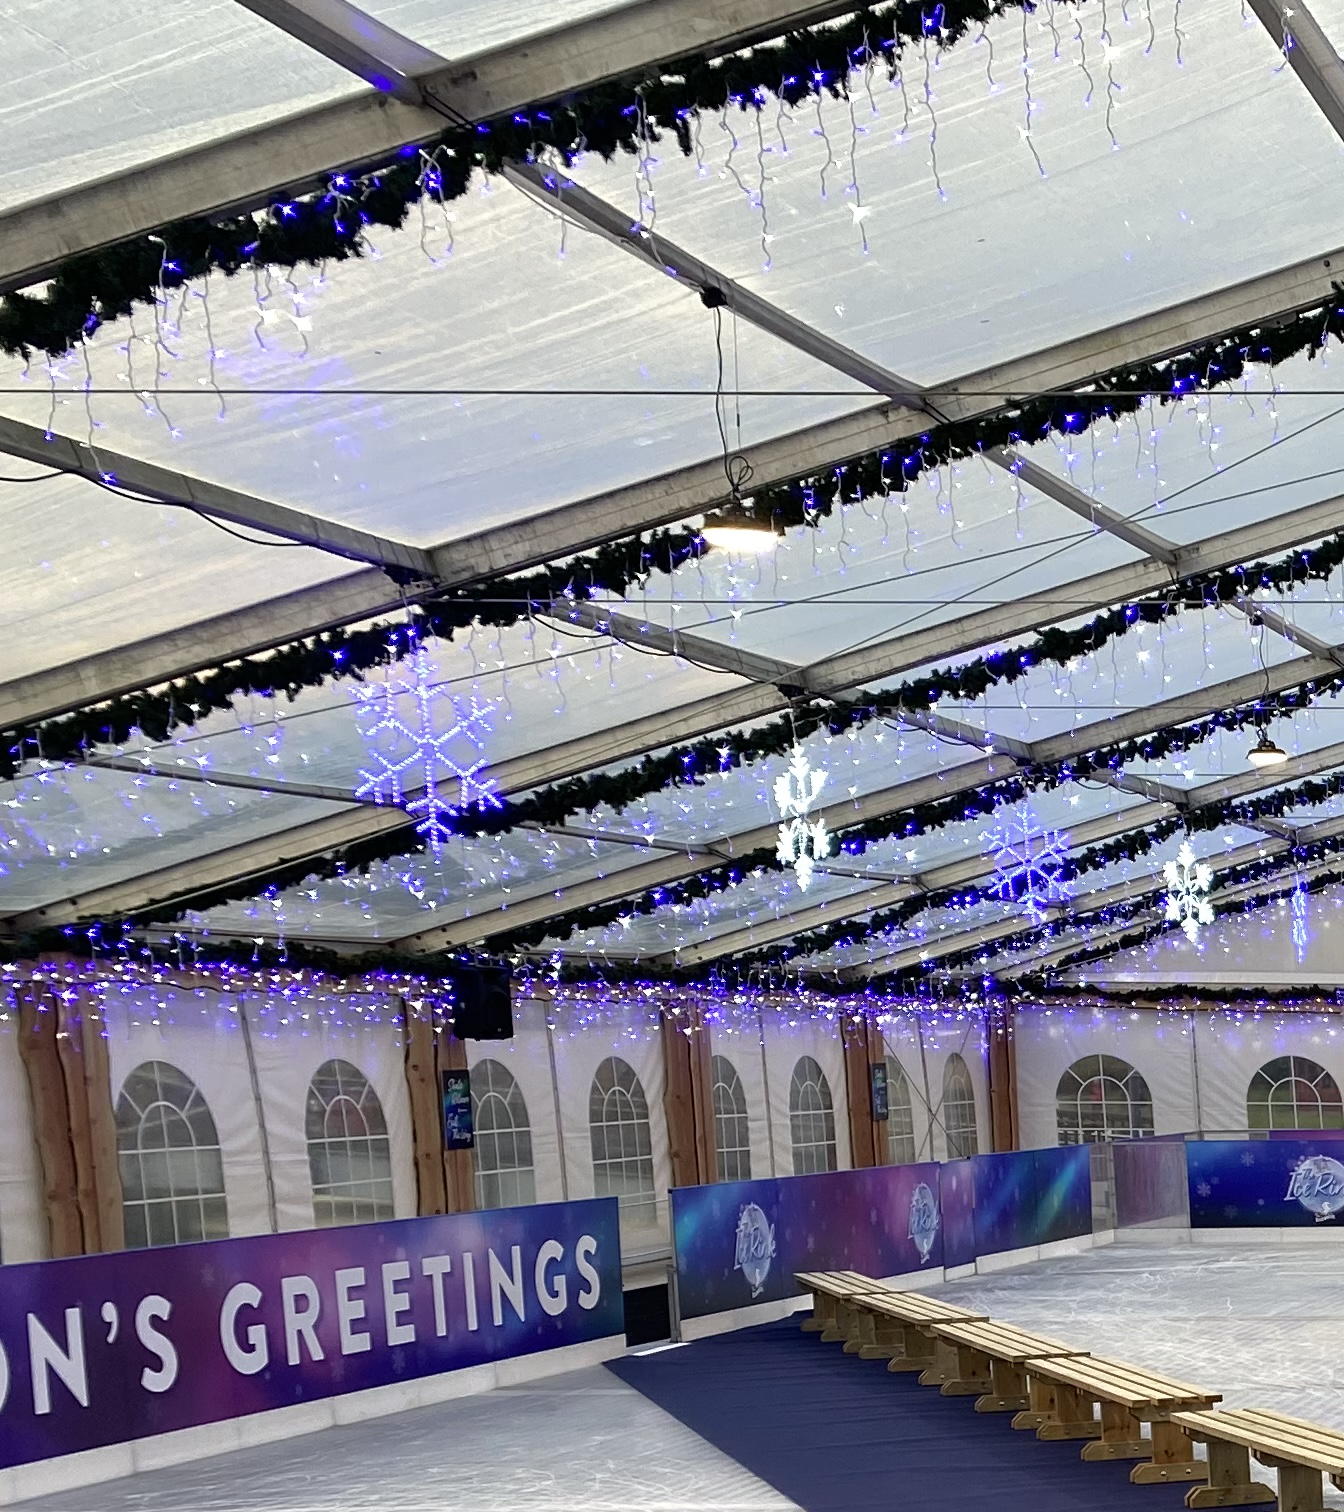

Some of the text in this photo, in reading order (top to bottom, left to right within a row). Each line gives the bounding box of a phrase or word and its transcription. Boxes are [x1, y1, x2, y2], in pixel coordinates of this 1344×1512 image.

[1283, 1171, 1311, 1201] Ice
[0, 1235, 600, 1415] N'S GREETINGS
